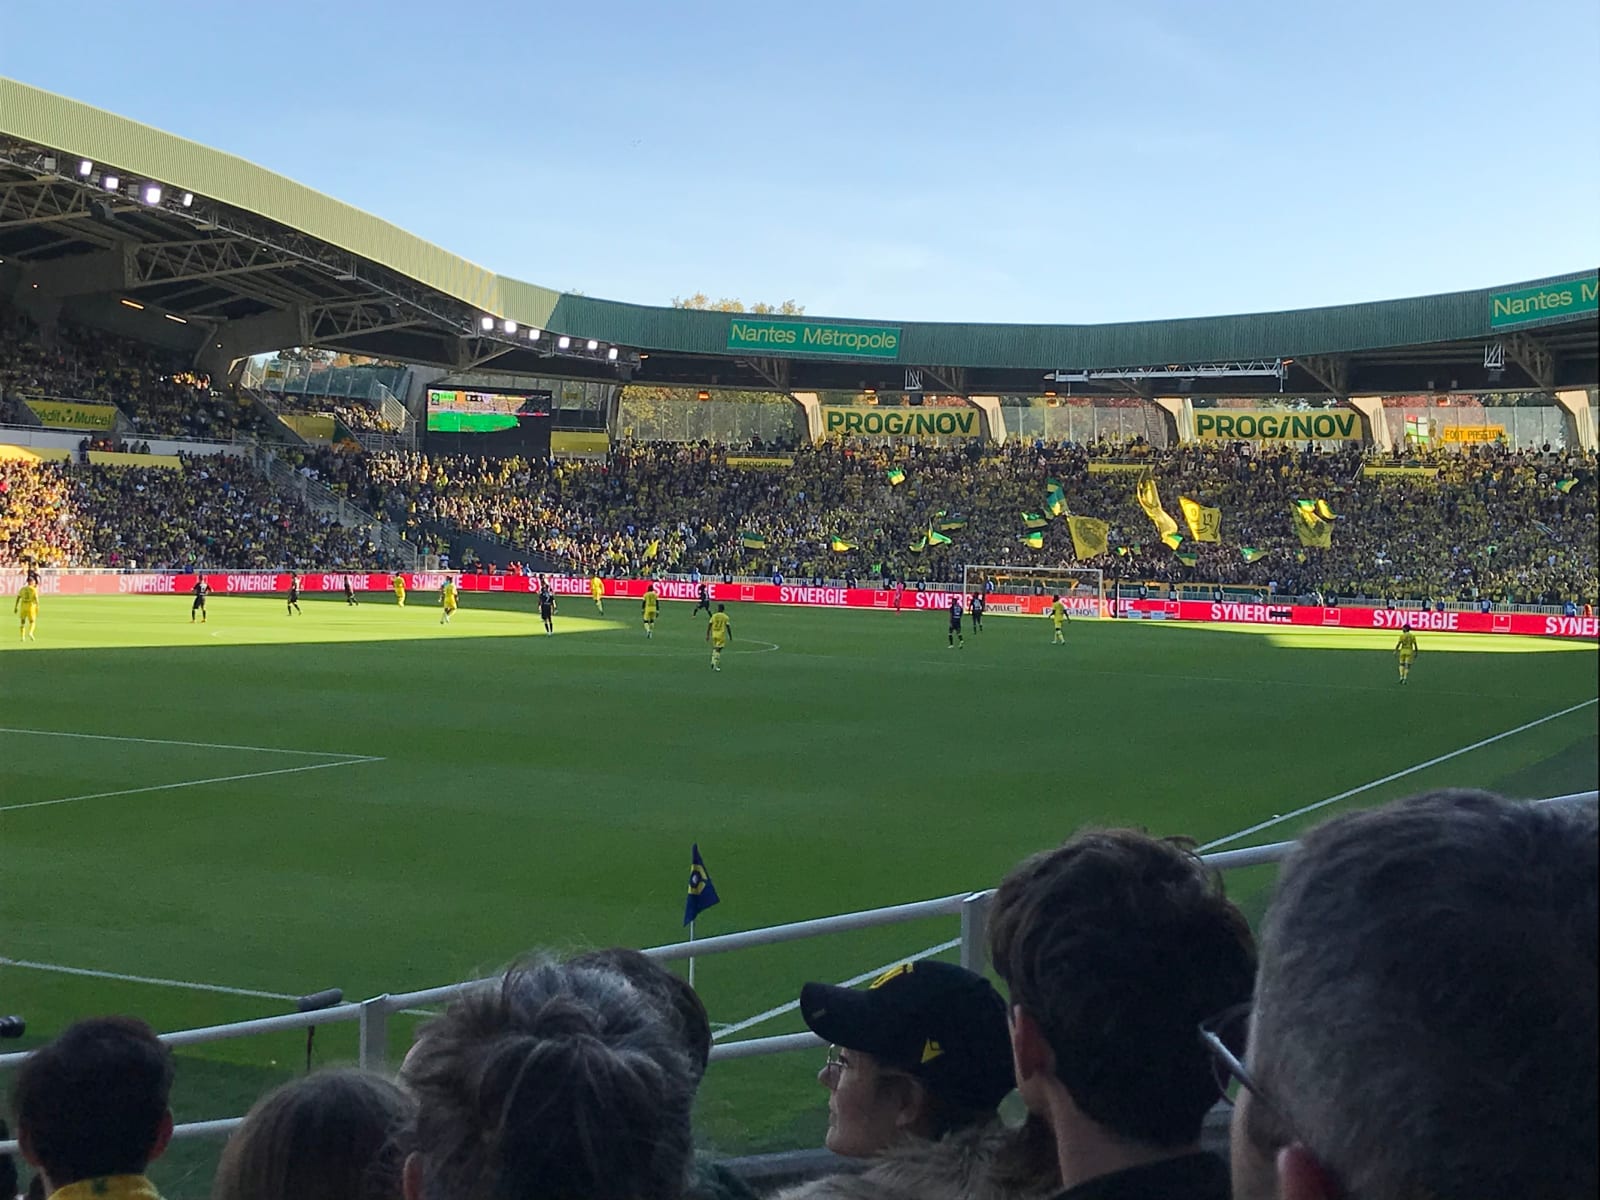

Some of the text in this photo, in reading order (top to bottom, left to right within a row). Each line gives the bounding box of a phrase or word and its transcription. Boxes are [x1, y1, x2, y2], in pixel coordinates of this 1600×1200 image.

[1494, 291, 1573, 318] Nantes
[731, 324, 796, 344] Nantes
[119, 575, 175, 592] SYNERGIE
[227, 575, 277, 591] SYNERGIE
[780, 586, 848, 604] SYNERGIE
[1373, 609, 1459, 630] SYNERGIE
